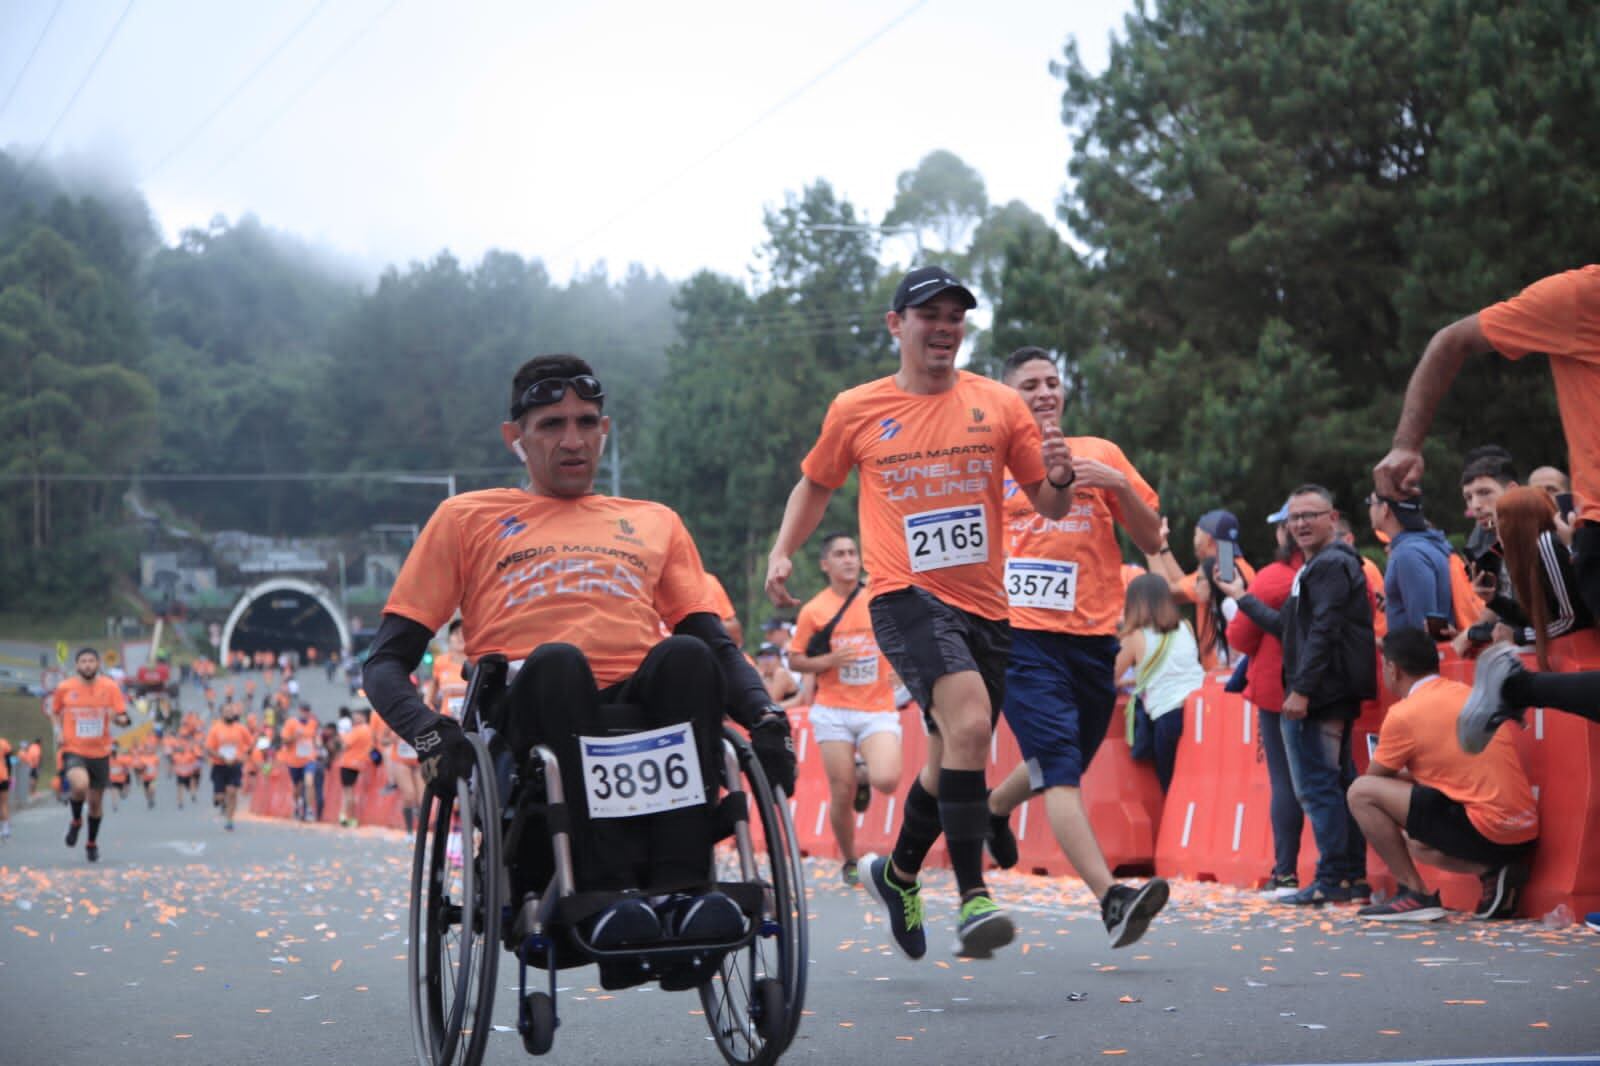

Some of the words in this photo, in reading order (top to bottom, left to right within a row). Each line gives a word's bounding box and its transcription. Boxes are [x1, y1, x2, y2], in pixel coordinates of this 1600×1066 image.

[876, 450, 923, 465] MEDIA
[887, 485, 919, 501] LA
[912, 522, 983, 557] 2165
[496, 545, 557, 572] MEDIA
[505, 582, 549, 609] LA
[1008, 574, 1070, 599] 3574
[591, 752, 689, 800] 3896
